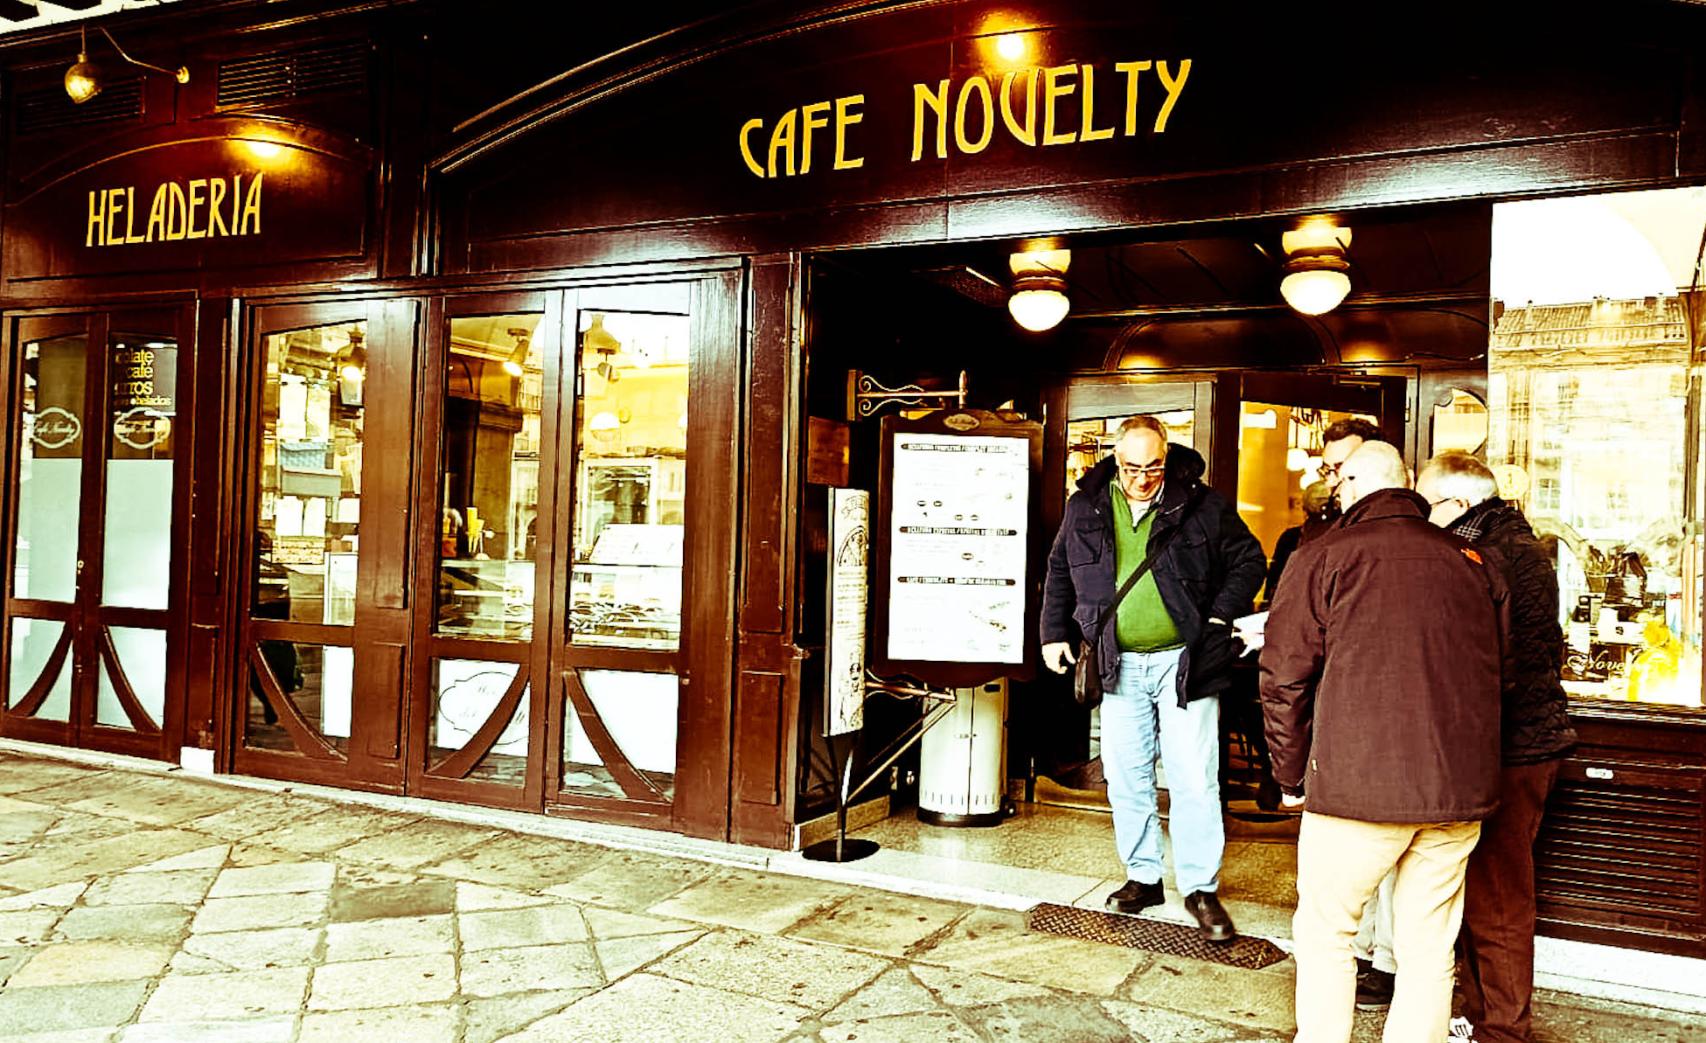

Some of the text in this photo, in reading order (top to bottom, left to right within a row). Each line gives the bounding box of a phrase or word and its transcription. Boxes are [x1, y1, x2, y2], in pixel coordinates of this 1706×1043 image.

[739, 59, 1192, 178] CAFE NOVELTY
[86, 173, 263, 247] HELADERIA
